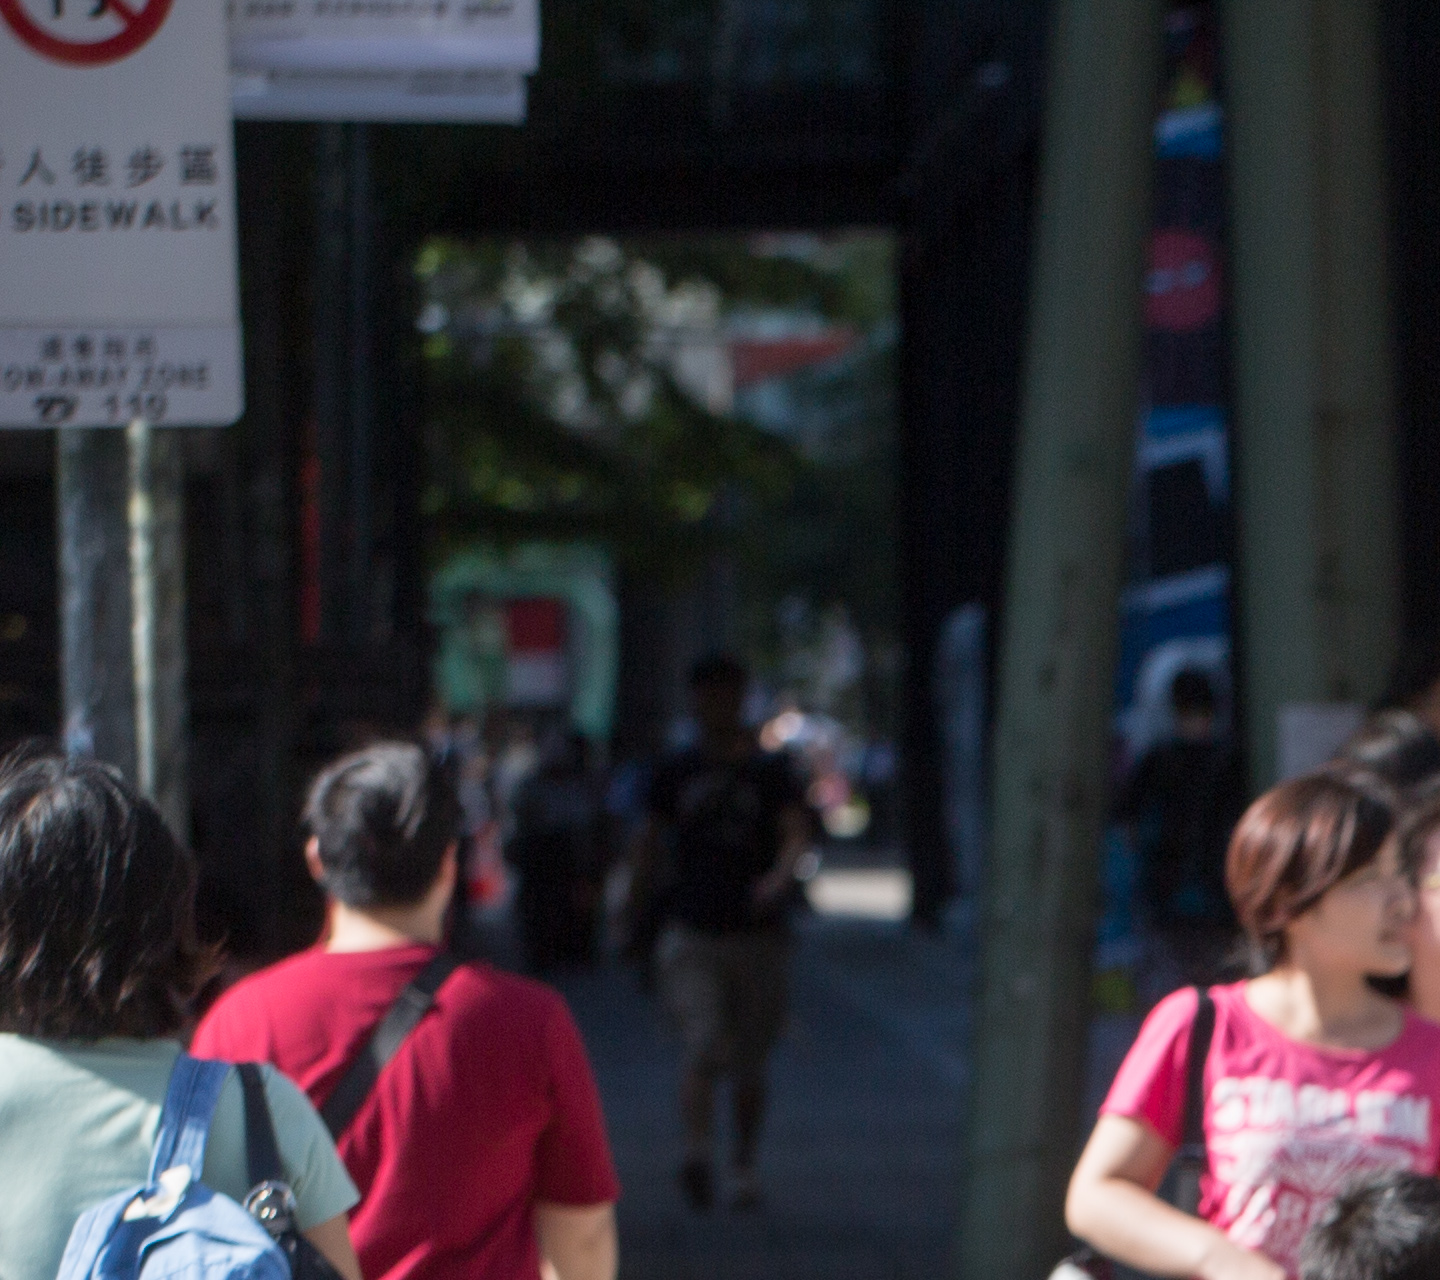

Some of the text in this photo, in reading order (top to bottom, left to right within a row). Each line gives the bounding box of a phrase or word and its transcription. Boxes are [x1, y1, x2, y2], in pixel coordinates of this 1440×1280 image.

[0, 144, 219, 188] 人徒步區
[11, 199, 220, 233] SIDEWALK
